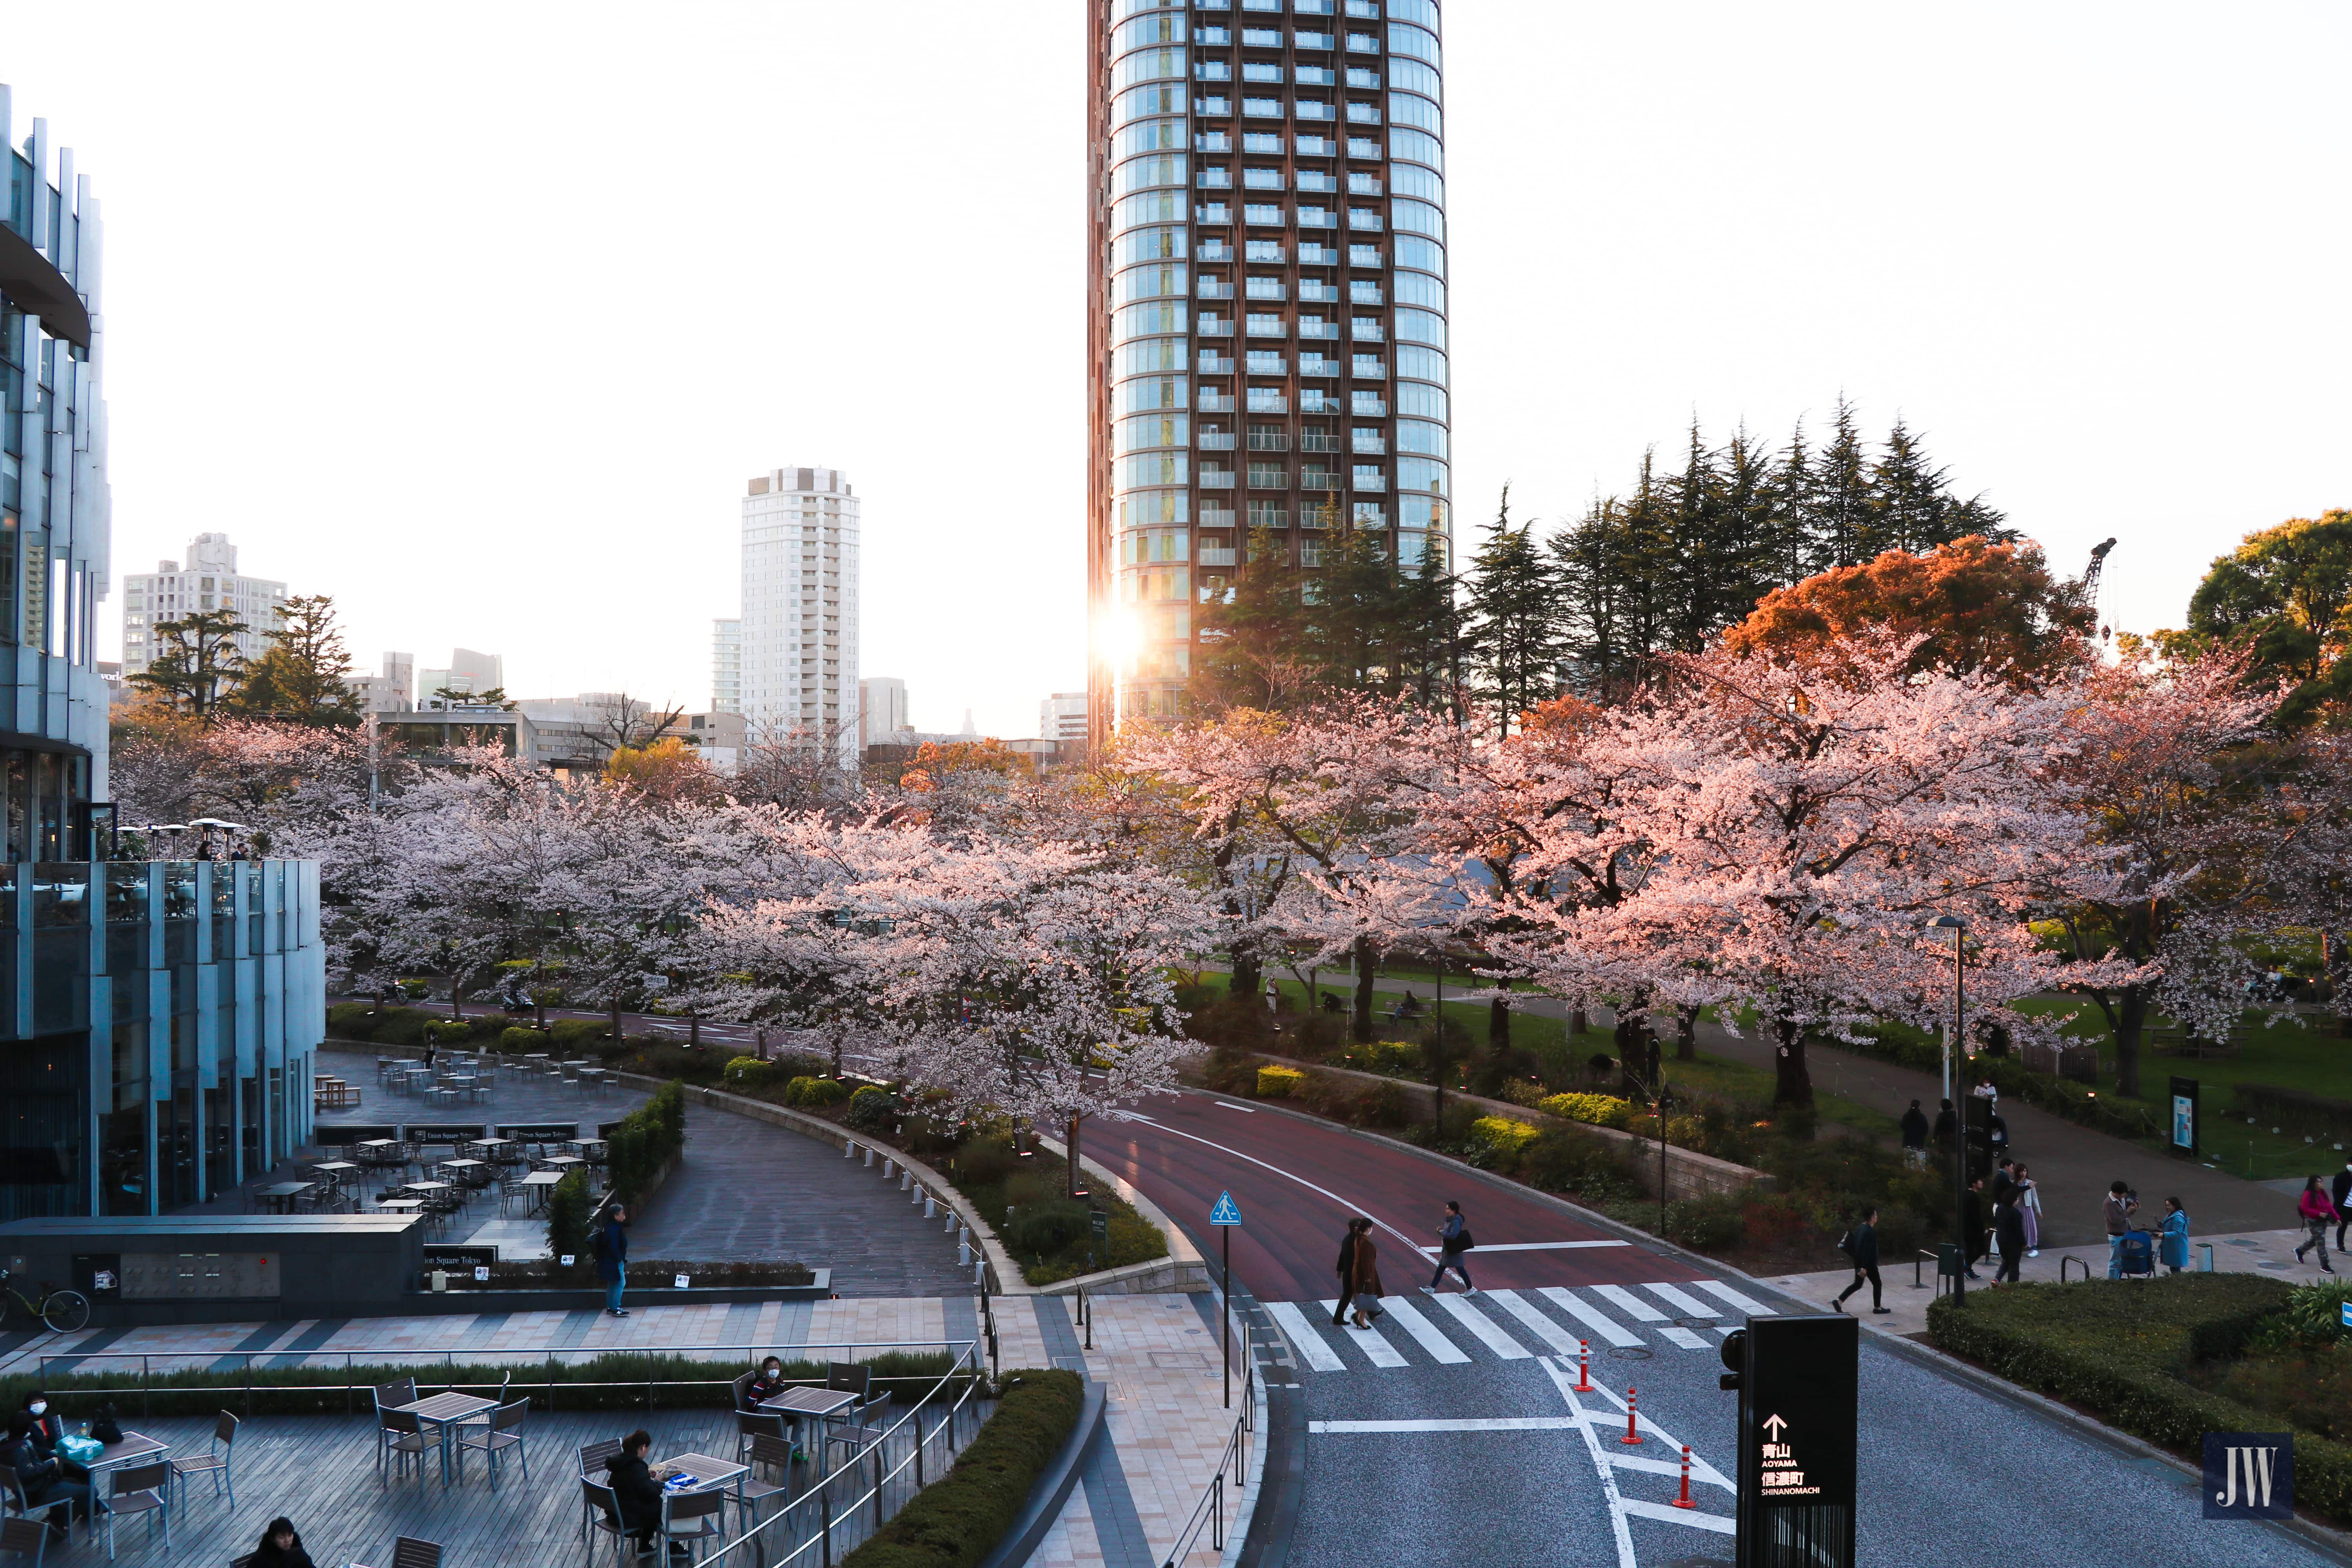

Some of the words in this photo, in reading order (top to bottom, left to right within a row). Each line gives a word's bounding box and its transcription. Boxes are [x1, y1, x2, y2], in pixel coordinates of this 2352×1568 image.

[437, 1256, 459, 1265] Square
[461, 1256, 481, 1265] Tokyo
[1762, 1443, 1790, 1458] 青山
[1762, 1471, 1804, 1486] 信濃町
[1761, 1487, 1820, 1495] SHINANOMACHI
